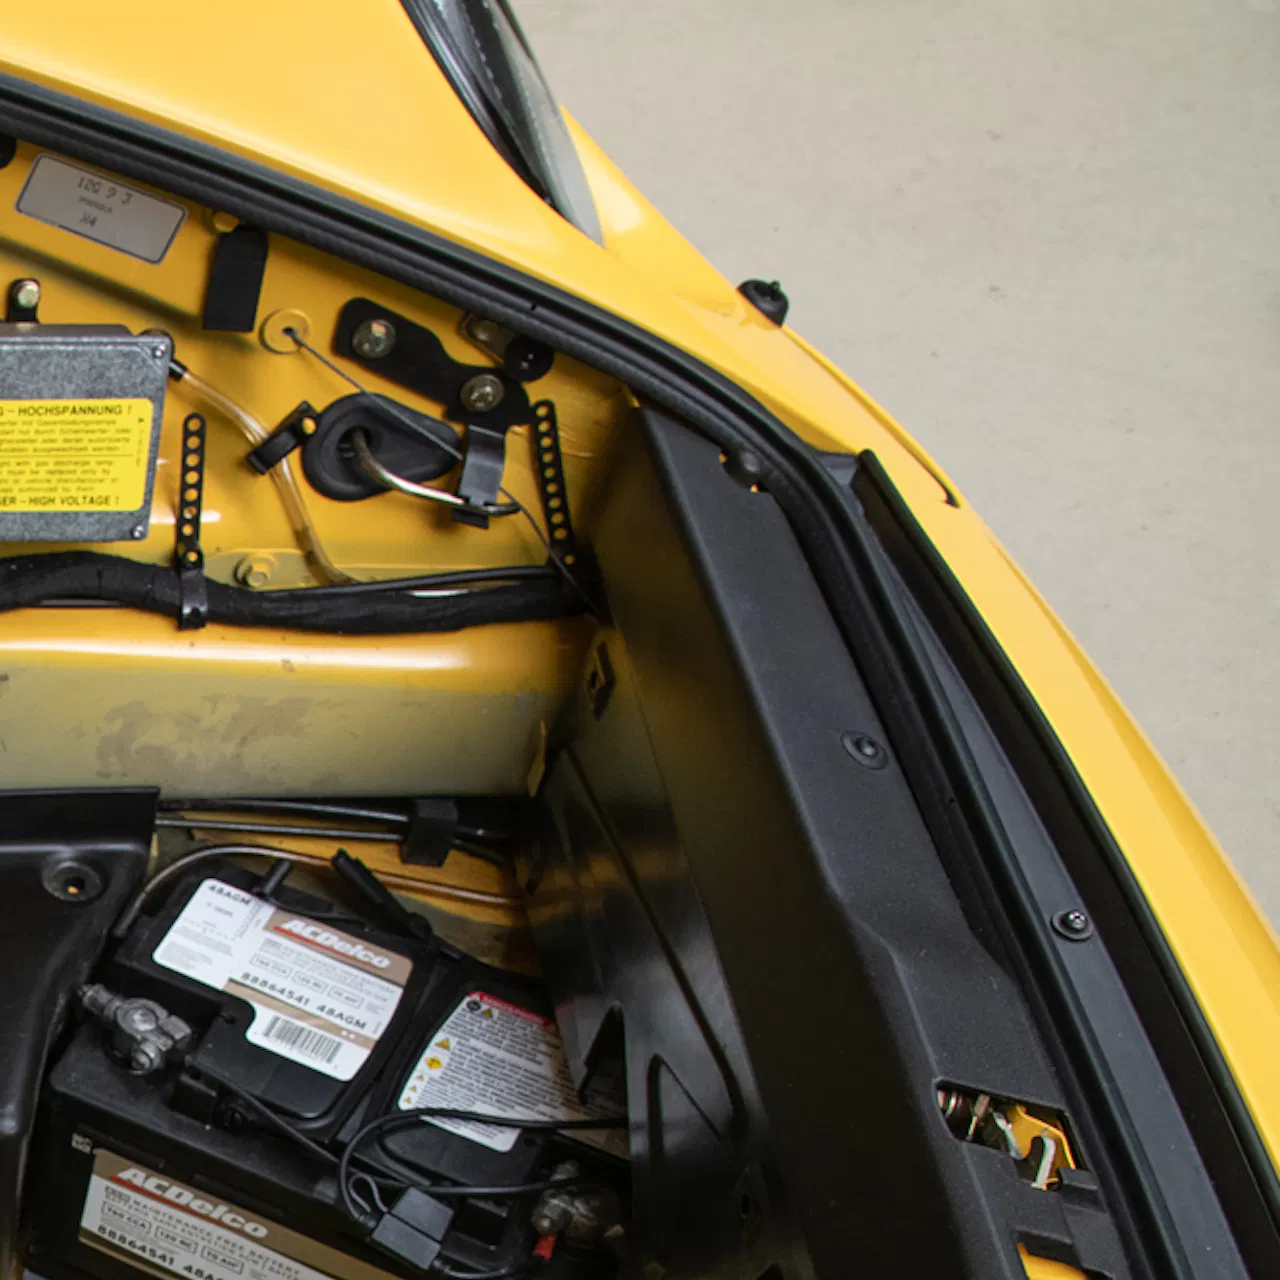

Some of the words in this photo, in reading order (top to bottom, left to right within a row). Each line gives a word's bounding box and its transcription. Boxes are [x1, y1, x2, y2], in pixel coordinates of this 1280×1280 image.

[18, 404, 123, 417] HOCHSPANNUNG
[28, 495, 56, 507] HIGH
[60, 495, 112, 507] VOLTAGE
[281, 919, 392, 969] ACDelco
[240, 972, 311, 1007] 88864541
[316, 1003, 367, 1030] 48AGM
[116, 1167, 269, 1239] ACDelco
[97, 1224, 175, 1266] 88864541
